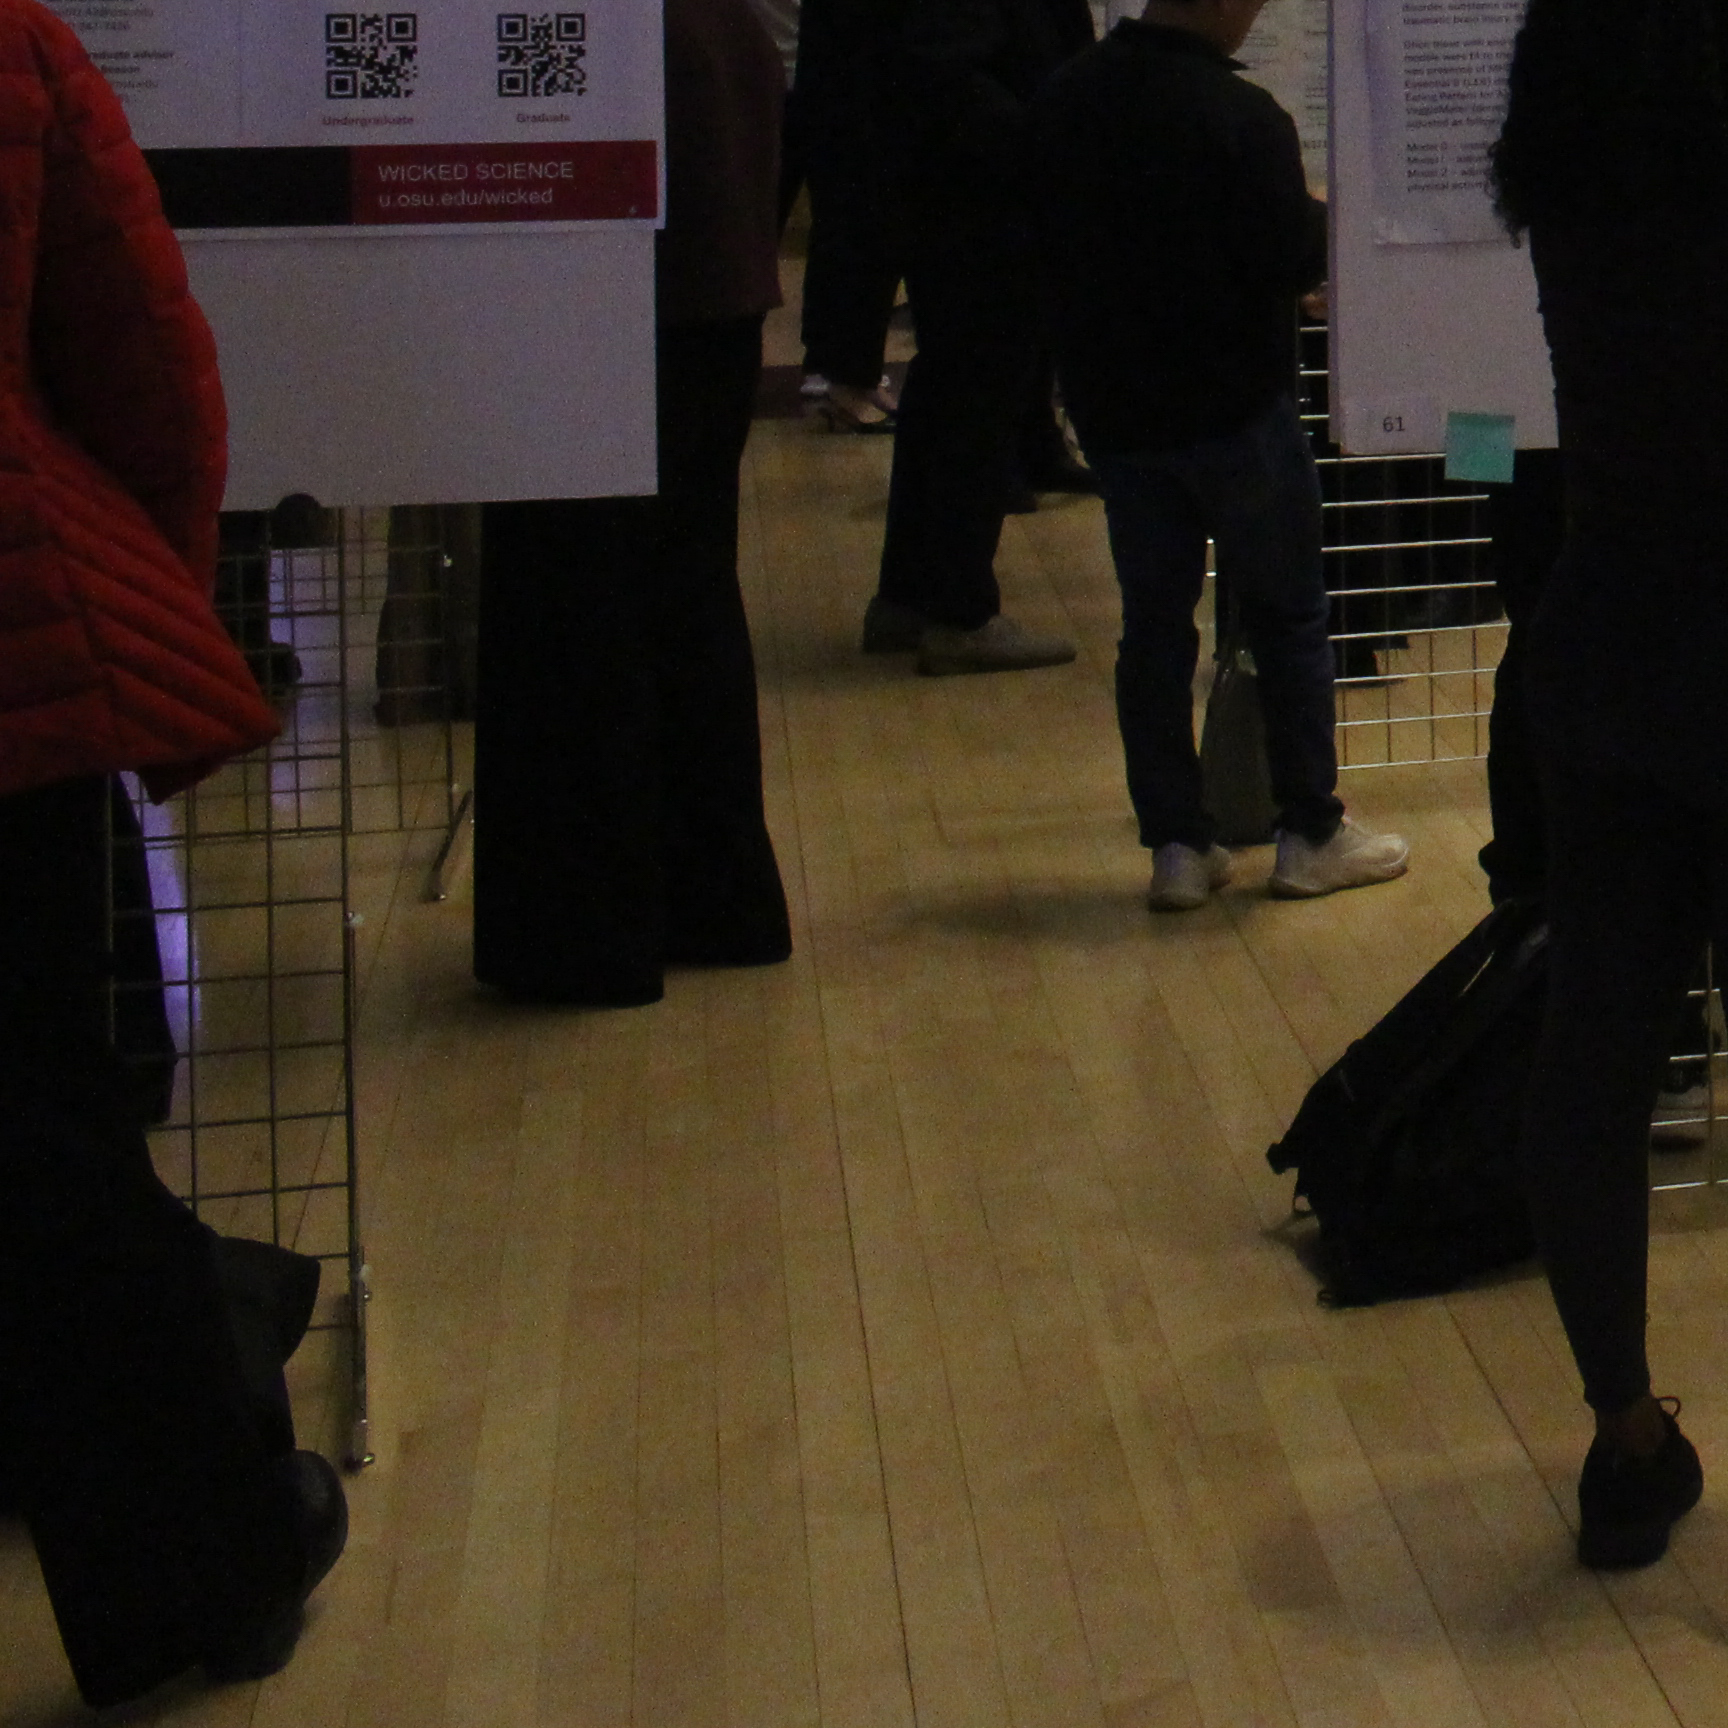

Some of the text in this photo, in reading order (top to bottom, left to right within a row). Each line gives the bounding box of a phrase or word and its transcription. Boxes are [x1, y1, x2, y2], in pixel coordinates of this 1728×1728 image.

[377, 161, 574, 182] WICKED SCIENCE
[378, 188, 553, 210] u.osu.edu/wicked
[1383, 417, 1406, 433] 61
